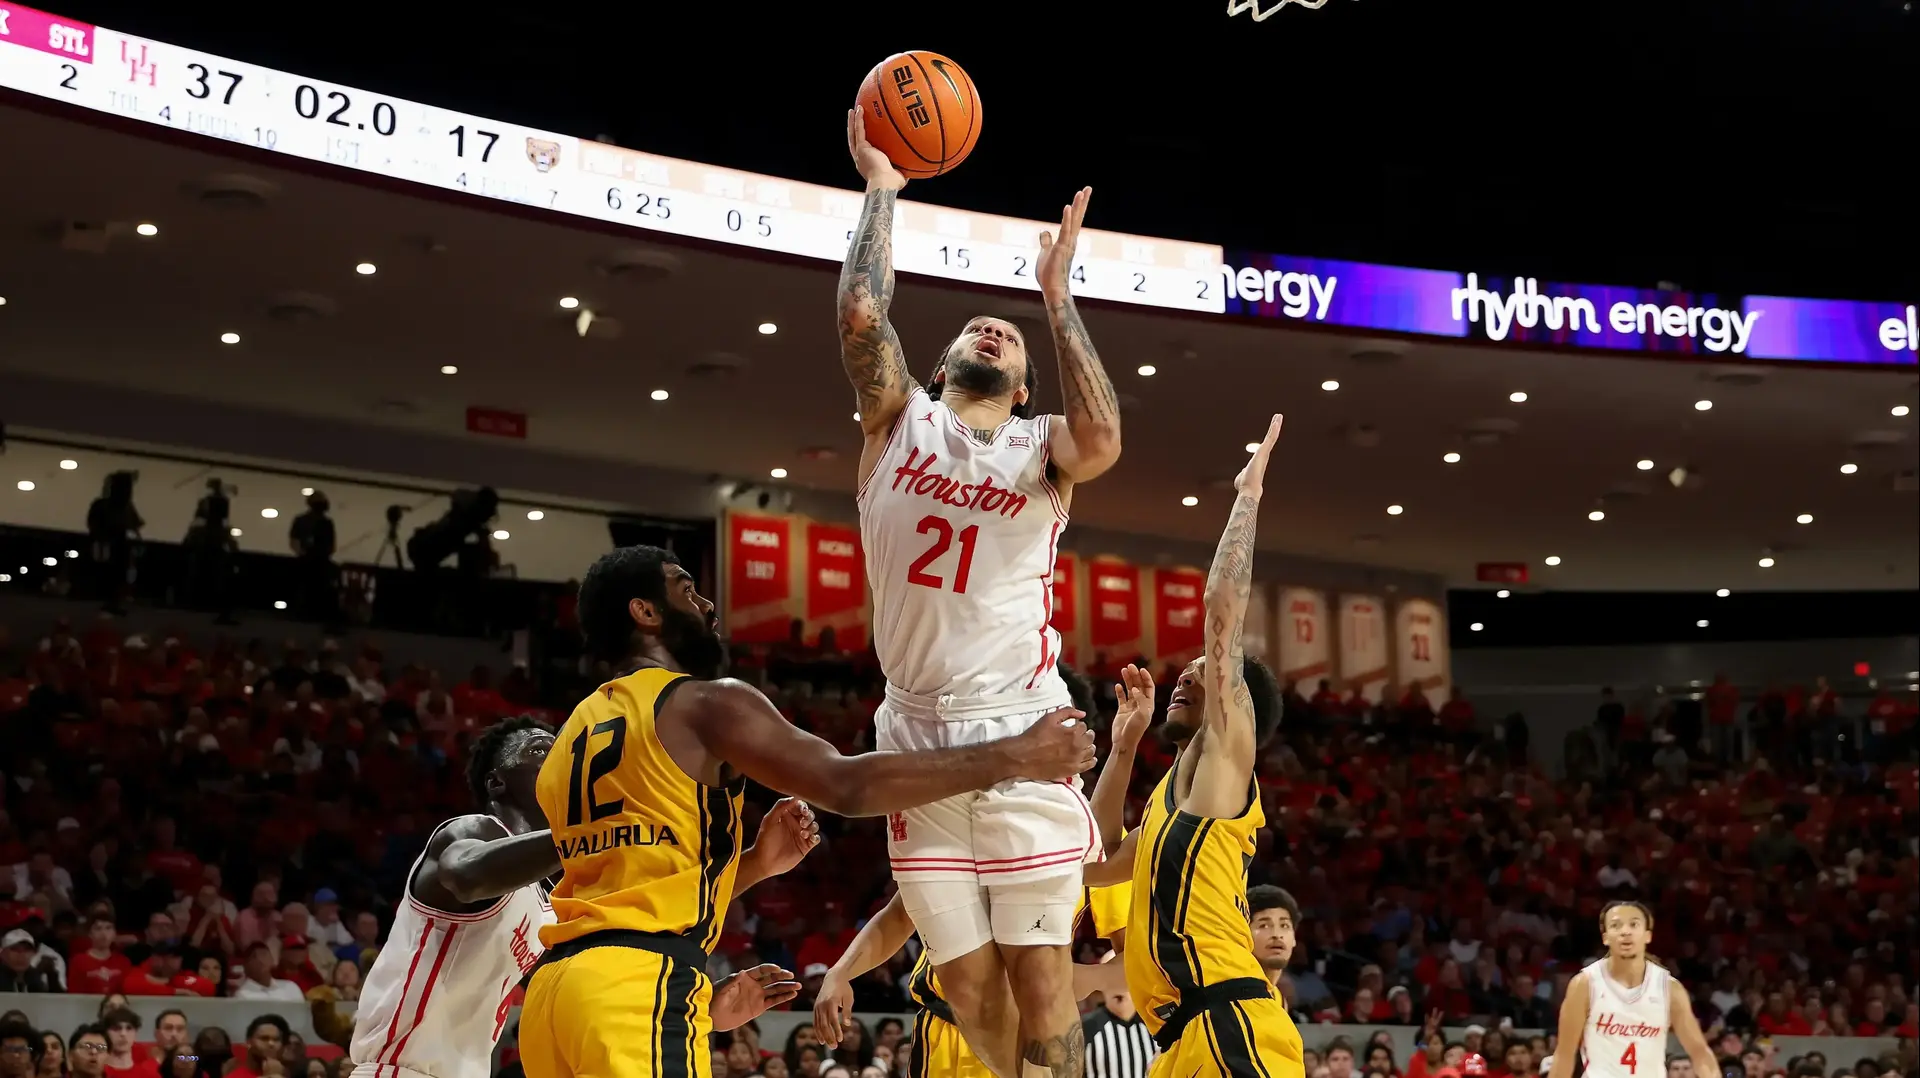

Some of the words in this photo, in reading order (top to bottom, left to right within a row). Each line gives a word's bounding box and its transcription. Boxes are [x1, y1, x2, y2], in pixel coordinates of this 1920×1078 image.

[49, 23, 89, 56] STL
[59, 64, 78, 90] 2
[892, 65, 931, 130] ELITE
[185, 62, 243, 105] 37
[294, 84, 397, 137] 02.0
[449, 124, 500, 163] 17
[158, 105, 172, 124] 4
[253, 126, 278, 149] 10
[456, 172, 467, 187] 4
[548, 188, 558, 208] 7
[606, 187, 622, 211] 6
[635, 193, 671, 220] 25
[727, 209, 742, 232] 0
[758, 215, 772, 238] 5
[939, 245, 971, 270] 15
[1013, 256, 1027, 277] 2
[1072, 265, 1087, 285] 4
[1133, 272, 1147, 293] 2
[1195, 280, 1210, 300] 2
[1451, 272, 1601, 341] rhythm
[1608, 301, 1762, 353] energy
[1878, 304, 1919, 351] el
[891, 446, 1028, 519] Houston
[907, 514, 980, 594] 21
[565, 716, 628, 828] 12
[555, 824, 680, 860] VALURUA
[1595, 1013, 1661, 1037] Houston
[1620, 1042, 1637, 1075] 4
